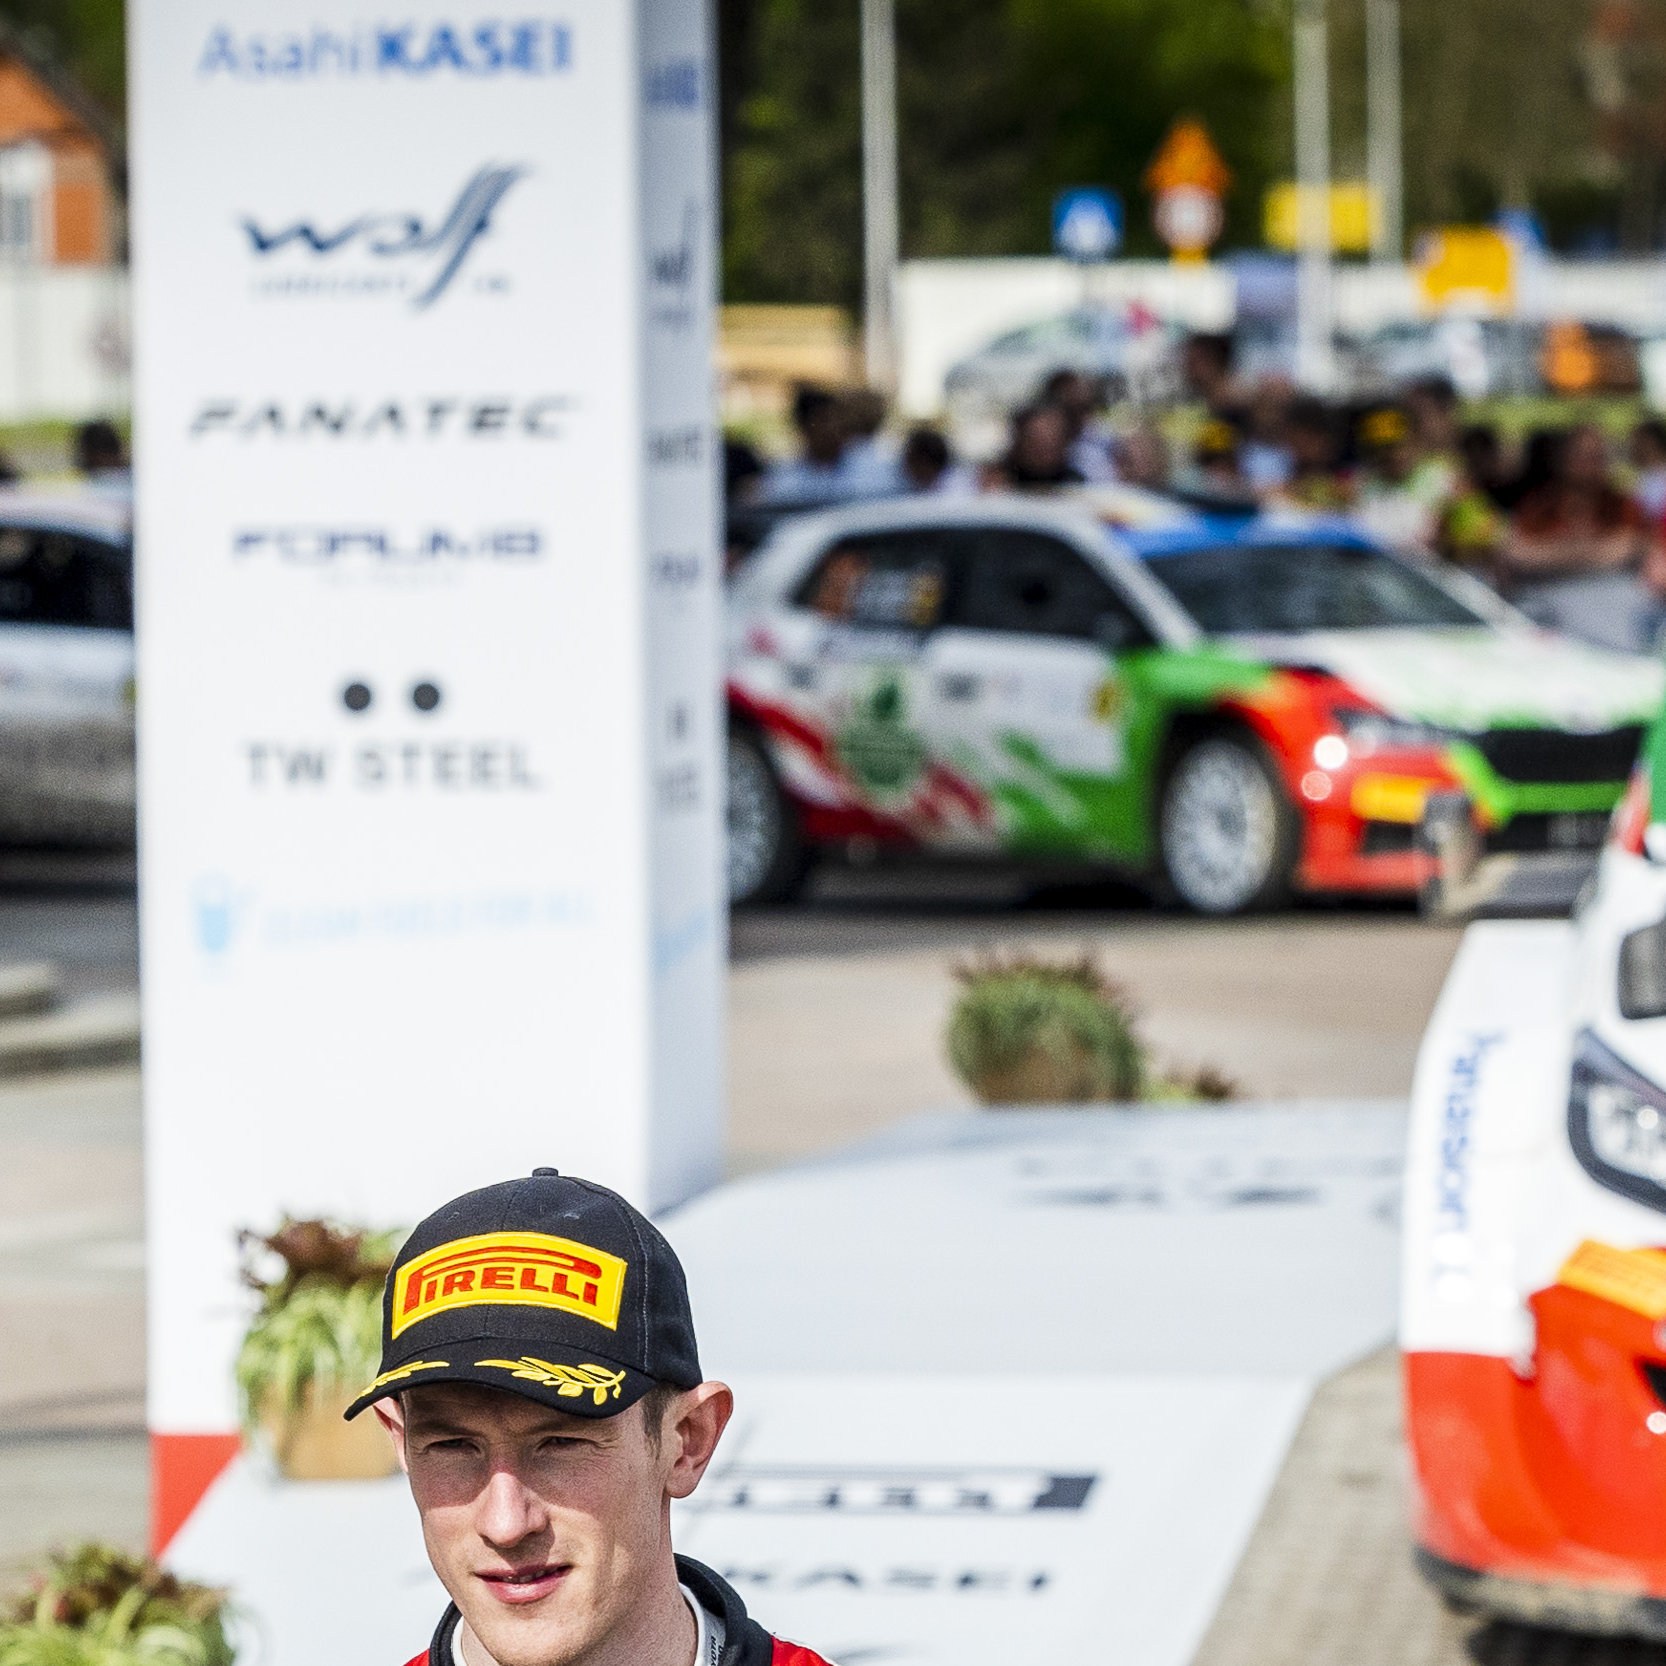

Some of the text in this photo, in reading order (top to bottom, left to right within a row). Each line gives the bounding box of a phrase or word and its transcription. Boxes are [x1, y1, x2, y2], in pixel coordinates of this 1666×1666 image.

[190, 398, 579, 440] FANATEC
[241, 741, 548, 792] TW STEEL
[403, 1246, 602, 1314] PIRELLI
